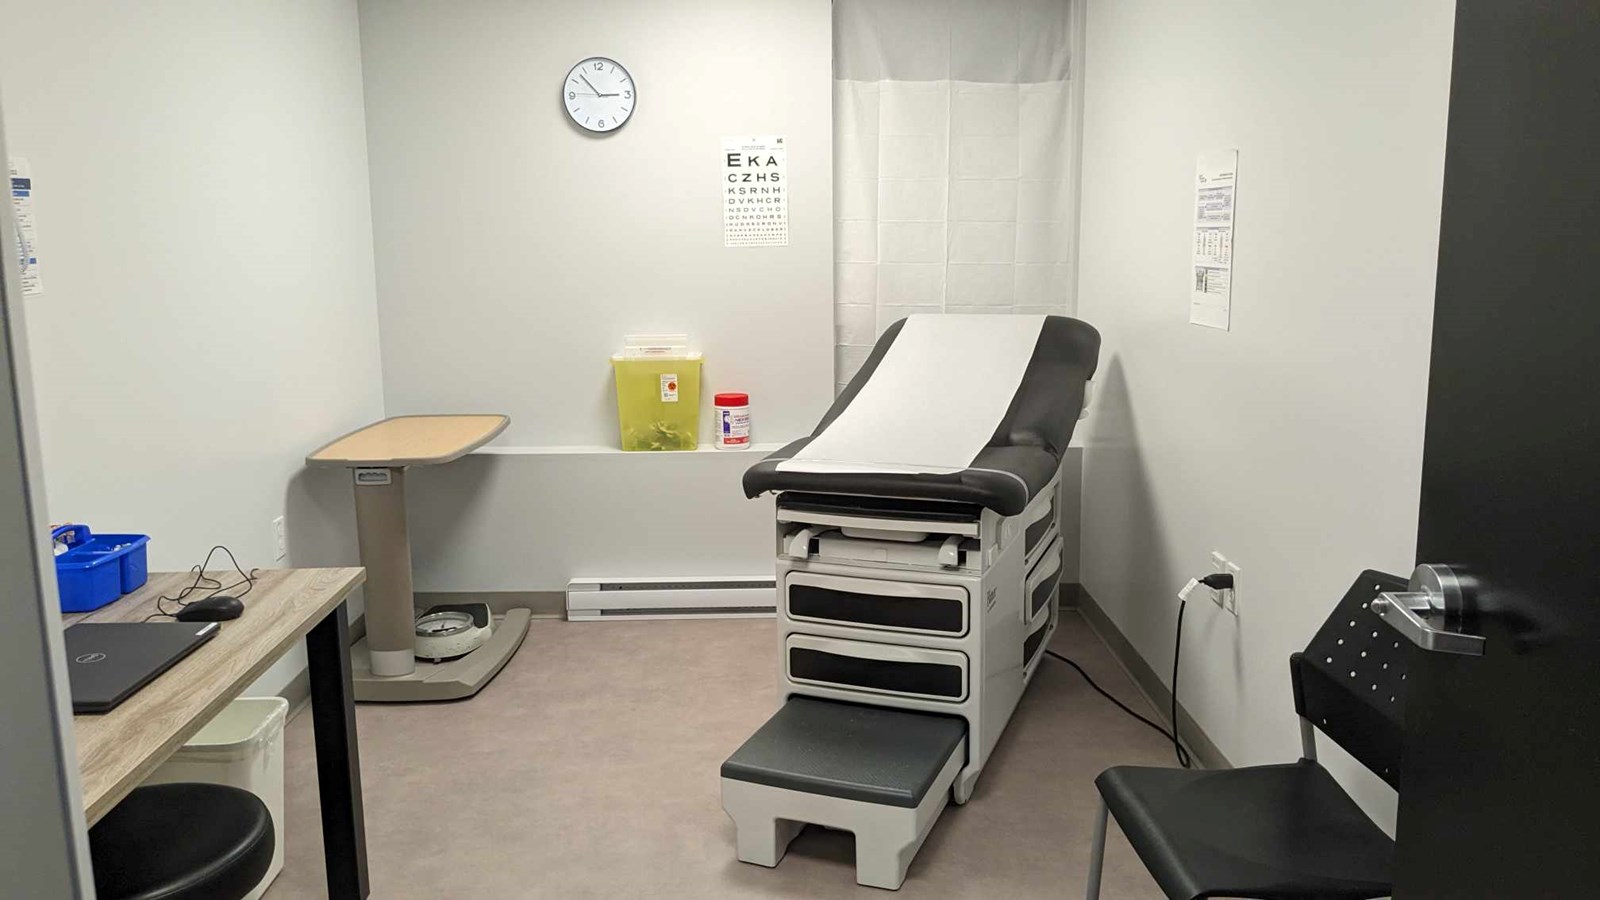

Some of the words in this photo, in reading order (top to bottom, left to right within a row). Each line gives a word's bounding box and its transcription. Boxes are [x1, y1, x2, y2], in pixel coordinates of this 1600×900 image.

[593, 62, 604, 71] 12
[568, 91, 577, 100] 9
[623, 90, 632, 100] 3
[597, 119, 605, 129] 6
